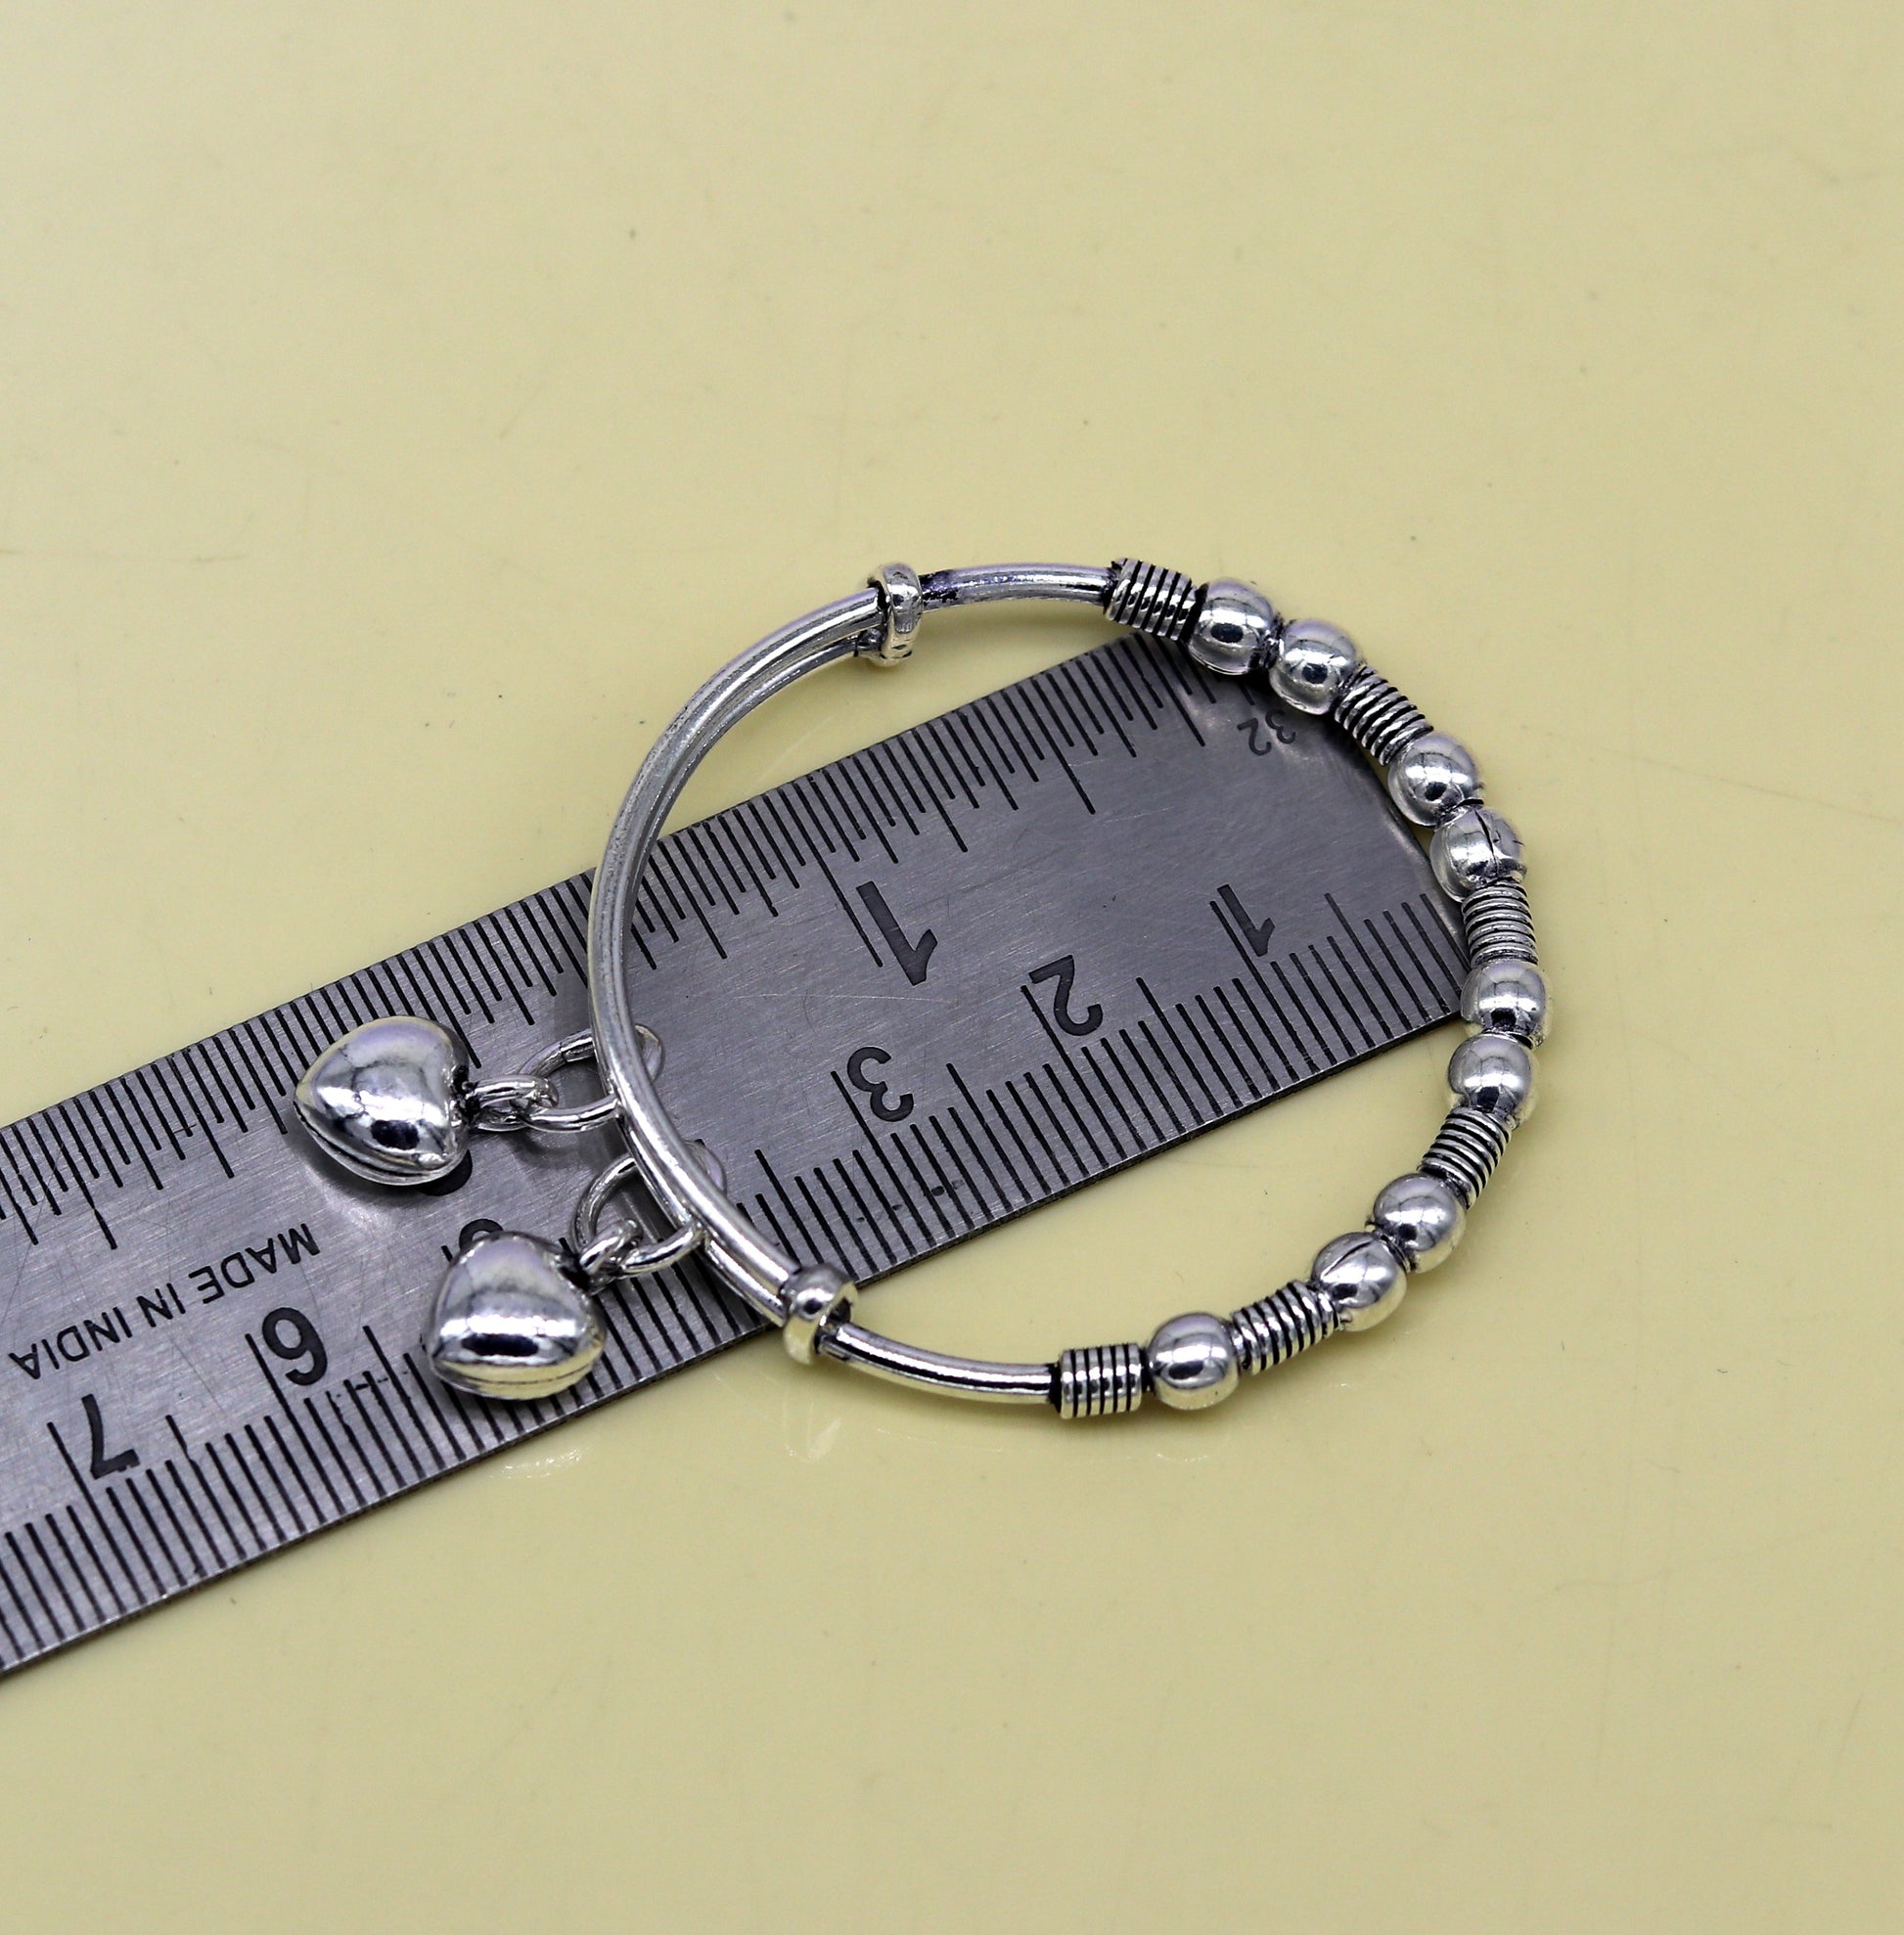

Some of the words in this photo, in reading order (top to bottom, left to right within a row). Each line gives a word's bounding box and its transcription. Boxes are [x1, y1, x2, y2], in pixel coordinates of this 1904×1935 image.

[1236, 708, 1296, 756] 32
[856, 880, 938, 986] 1
[1217, 883, 1275, 957] 1
[1028, 955, 1104, 1036] 2
[846, 1046, 914, 1122] 3
[188, 1223, 320, 1304] MADE
[8, 1307, 133, 1379] INDIA
[136, 1282, 187, 1328] IN
[261, 1307, 328, 1385] 6
[81, 1394, 141, 1479] 7
